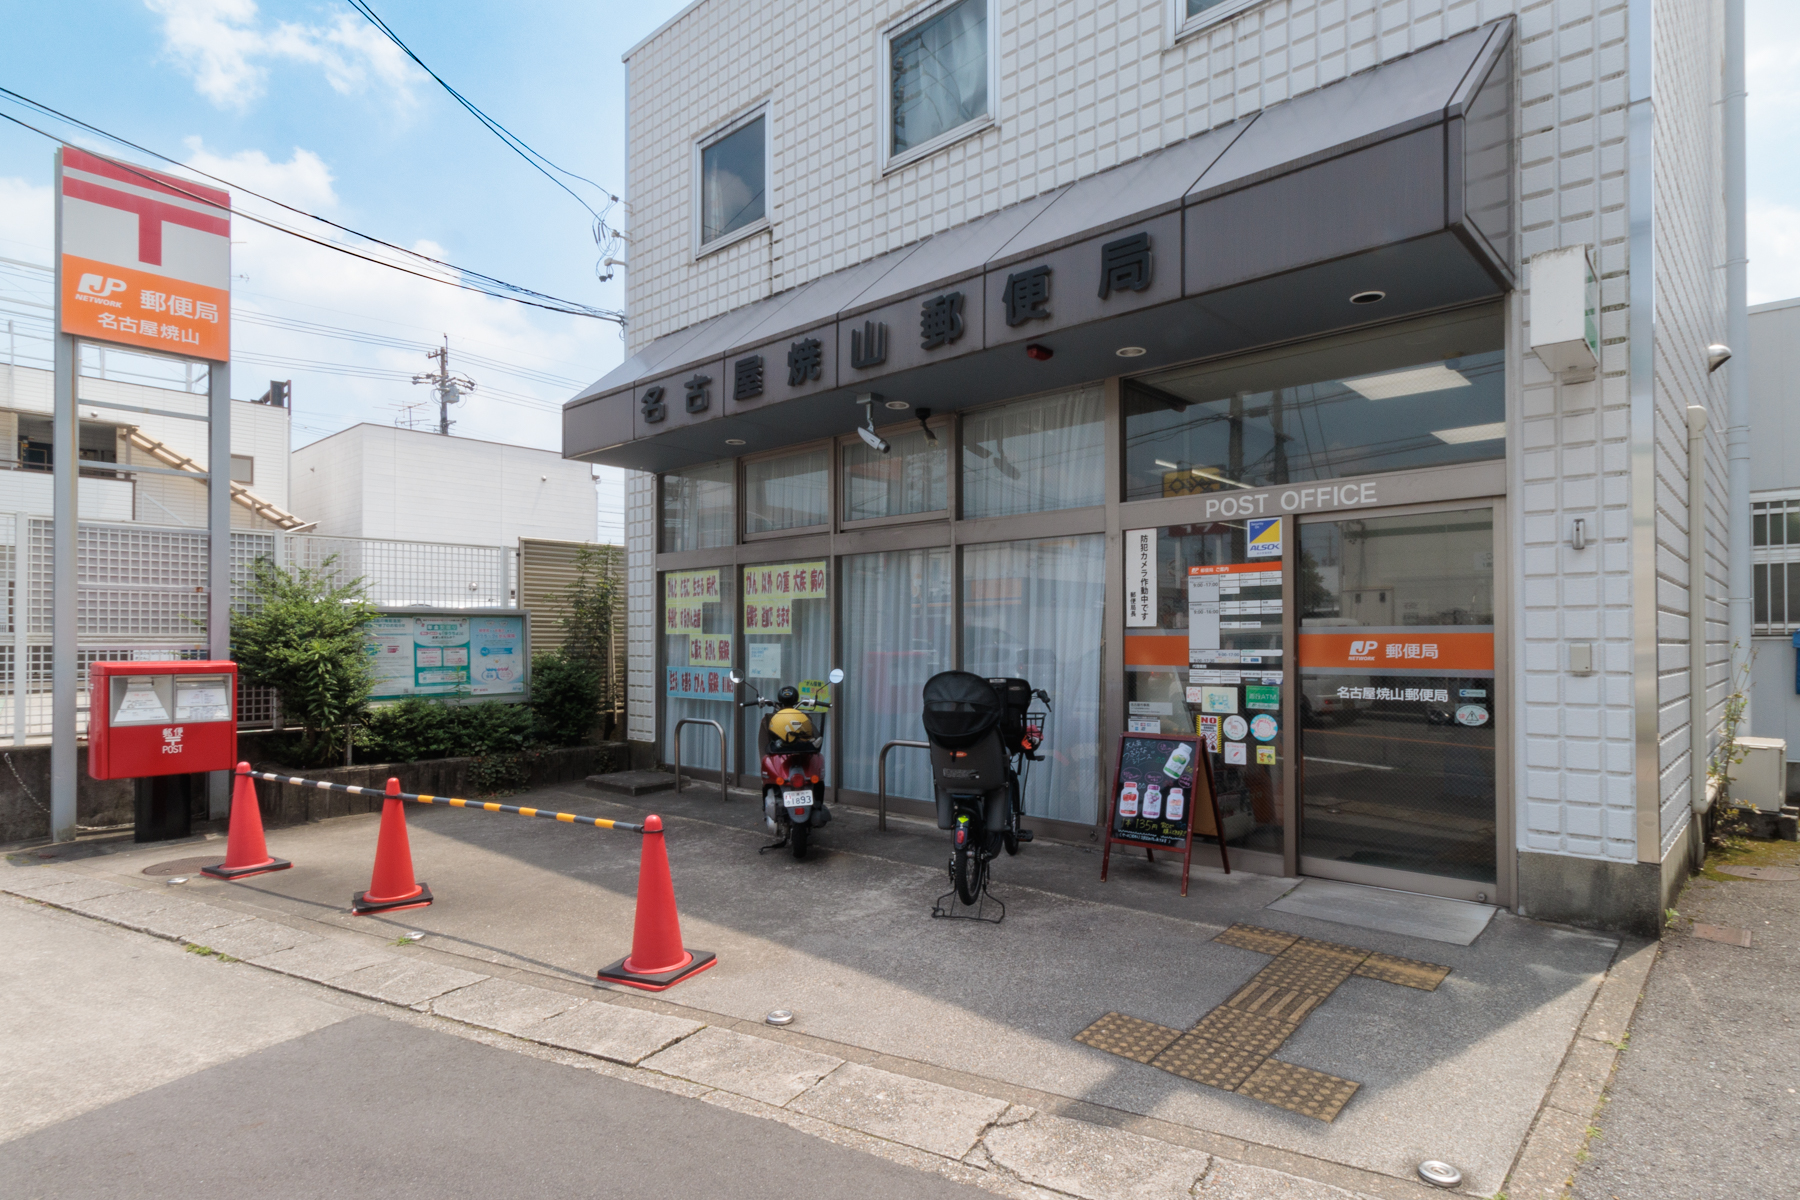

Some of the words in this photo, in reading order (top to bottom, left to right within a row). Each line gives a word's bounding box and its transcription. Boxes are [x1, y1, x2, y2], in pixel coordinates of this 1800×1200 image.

[77, 273, 127, 297] JP
[75, 293, 123, 308] NETWORK
[140, 290, 219, 324] 郵便局
[97, 312, 200, 345] 名古屋焼山
[640, 231, 1155, 424] 名古屋焼山郵便局
[1205, 494, 1269, 518] POST
[1280, 482, 1378, 511] OFFICE
[1249, 543, 1280, 551] ALSOK
[1140, 535, 1149, 621] 防犯カメラ作動中です
[1349, 640, 1378, 655] JP
[1385, 643, 1439, 659] 郵便局
[1336, 686, 1449, 702] 名古屋焼山郵便局
[162, 727, 184, 737] 郵便
[162, 745, 184, 754] POST
[792, 796, 811, 805] 1893
[1135, 818, 1159, 831] 135円
